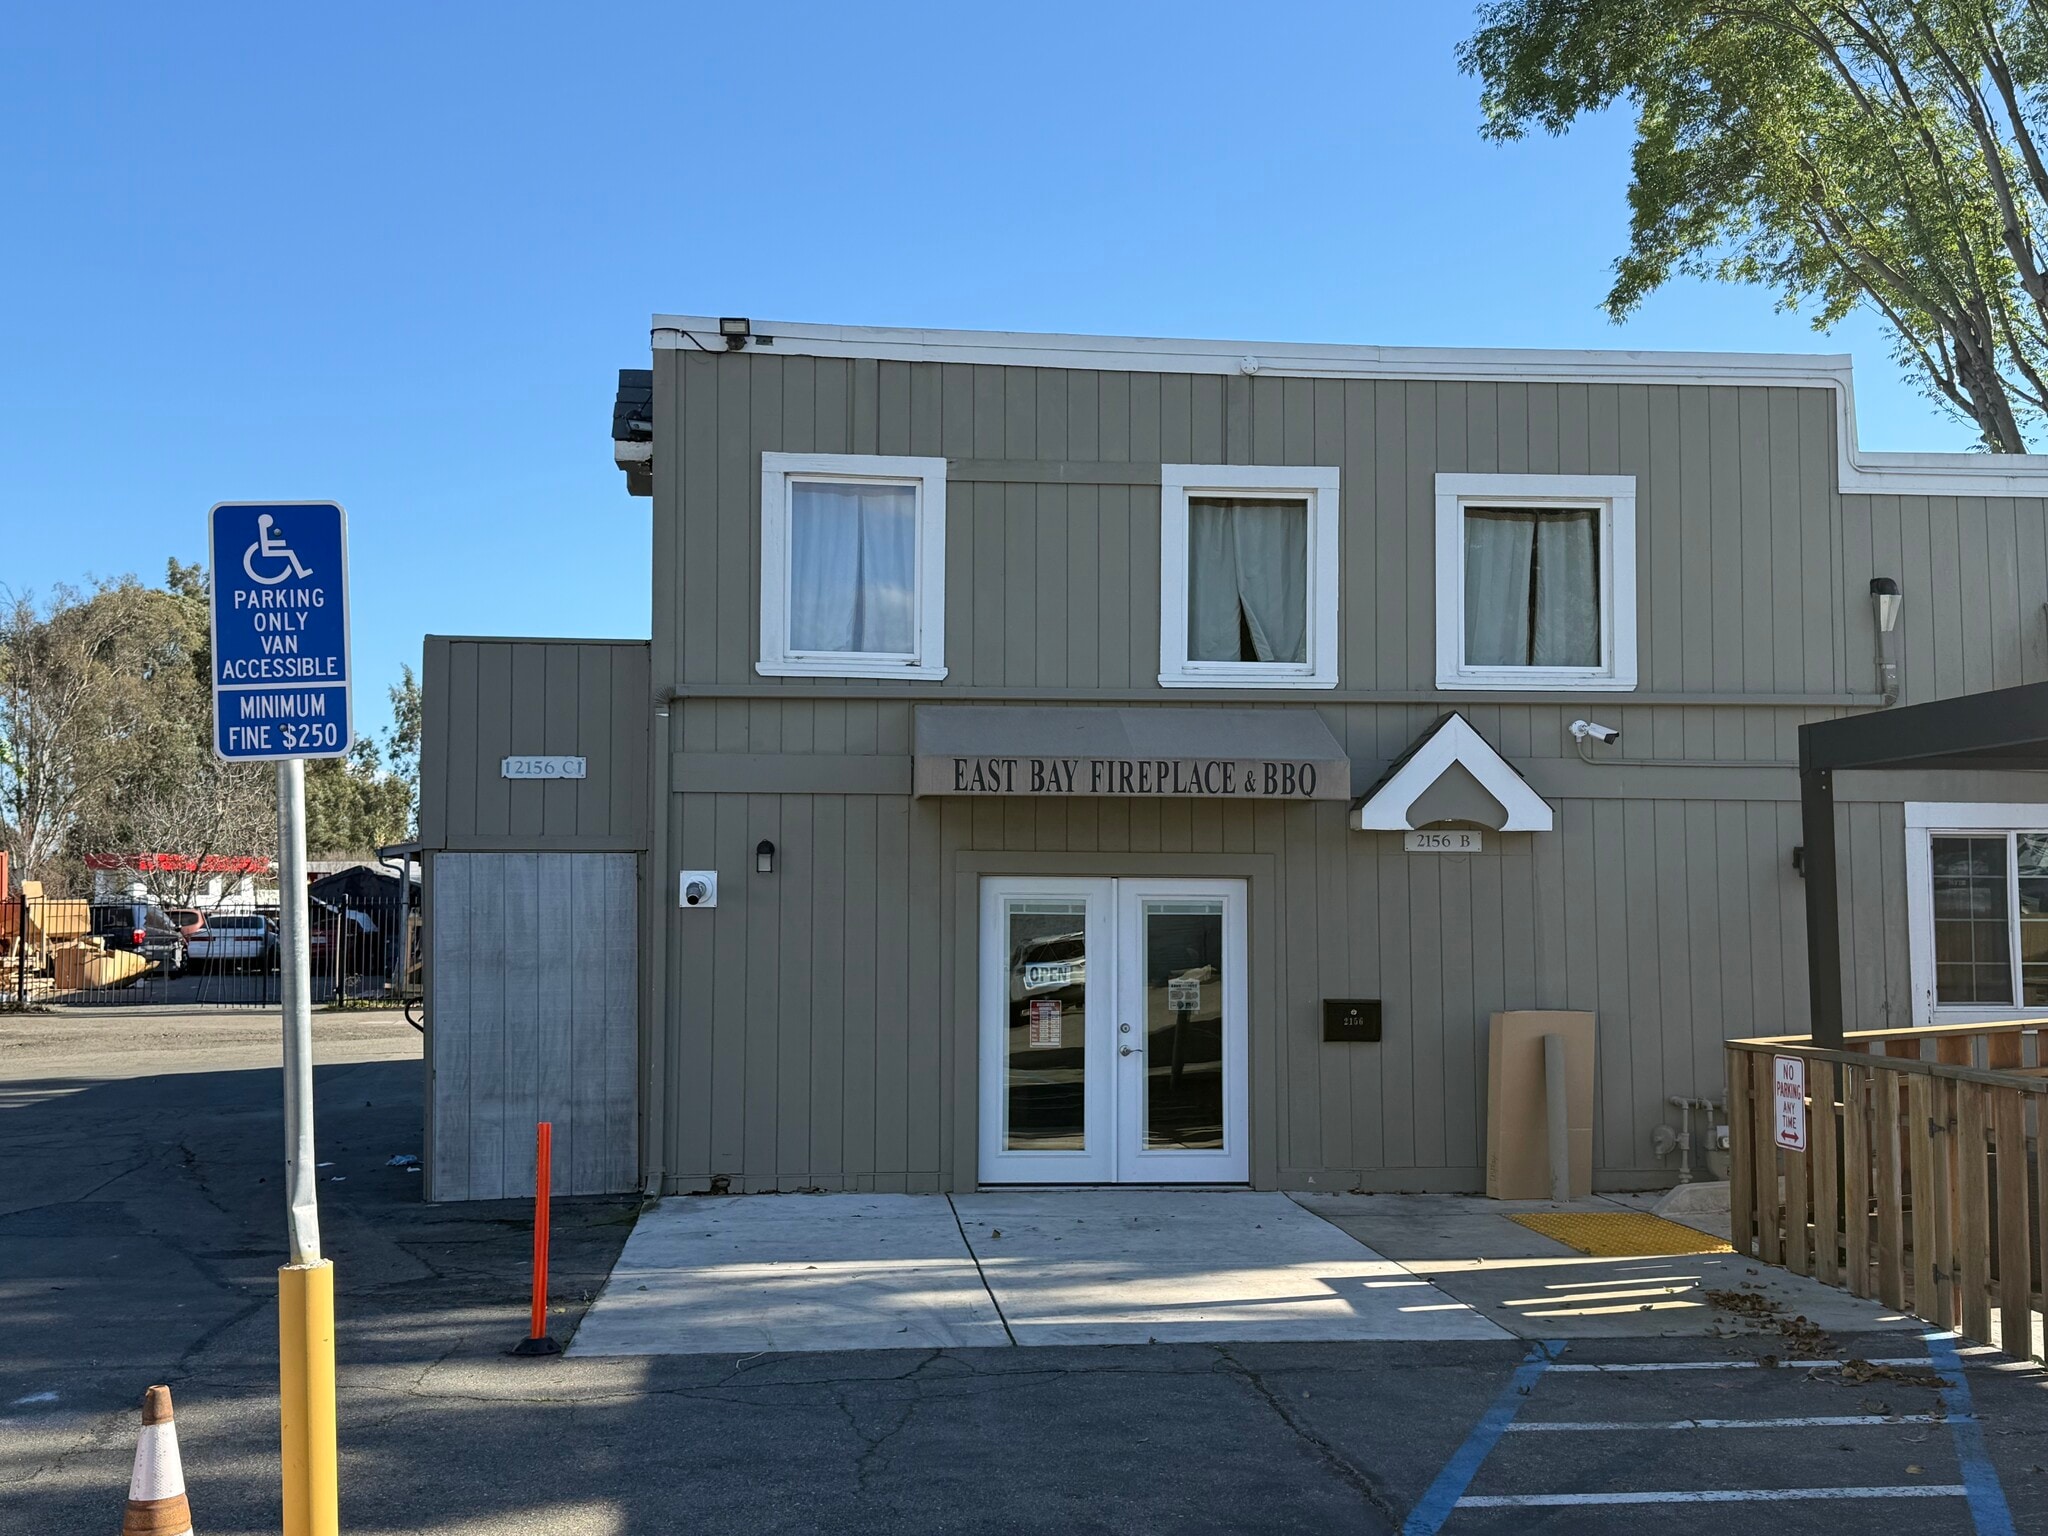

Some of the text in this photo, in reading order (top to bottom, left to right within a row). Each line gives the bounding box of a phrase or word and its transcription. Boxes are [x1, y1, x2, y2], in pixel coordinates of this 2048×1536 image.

[234, 588, 325, 609] PARKING
[254, 612, 308, 631] ONLY
[260, 635, 298, 654] VAN
[222, 657, 338, 679] ACCESSIBLE
[240, 693, 326, 719] MINIMUM
[229, 722, 338, 750] FINE $250
[514, 760, 575, 774] 2156 C
[953, 758, 1317, 798] EAST BAY FIREPLACE & BBQ
[1416, 834, 1471, 848] 2156 B
[1030, 966, 1067, 981] OPEN
[1783, 1063, 1794, 1080] NO
[1777, 1081, 1801, 1100] PARKING
[1782, 1101, 1796, 1115] ANY
[1782, 1114, 1797, 1129] TIME
